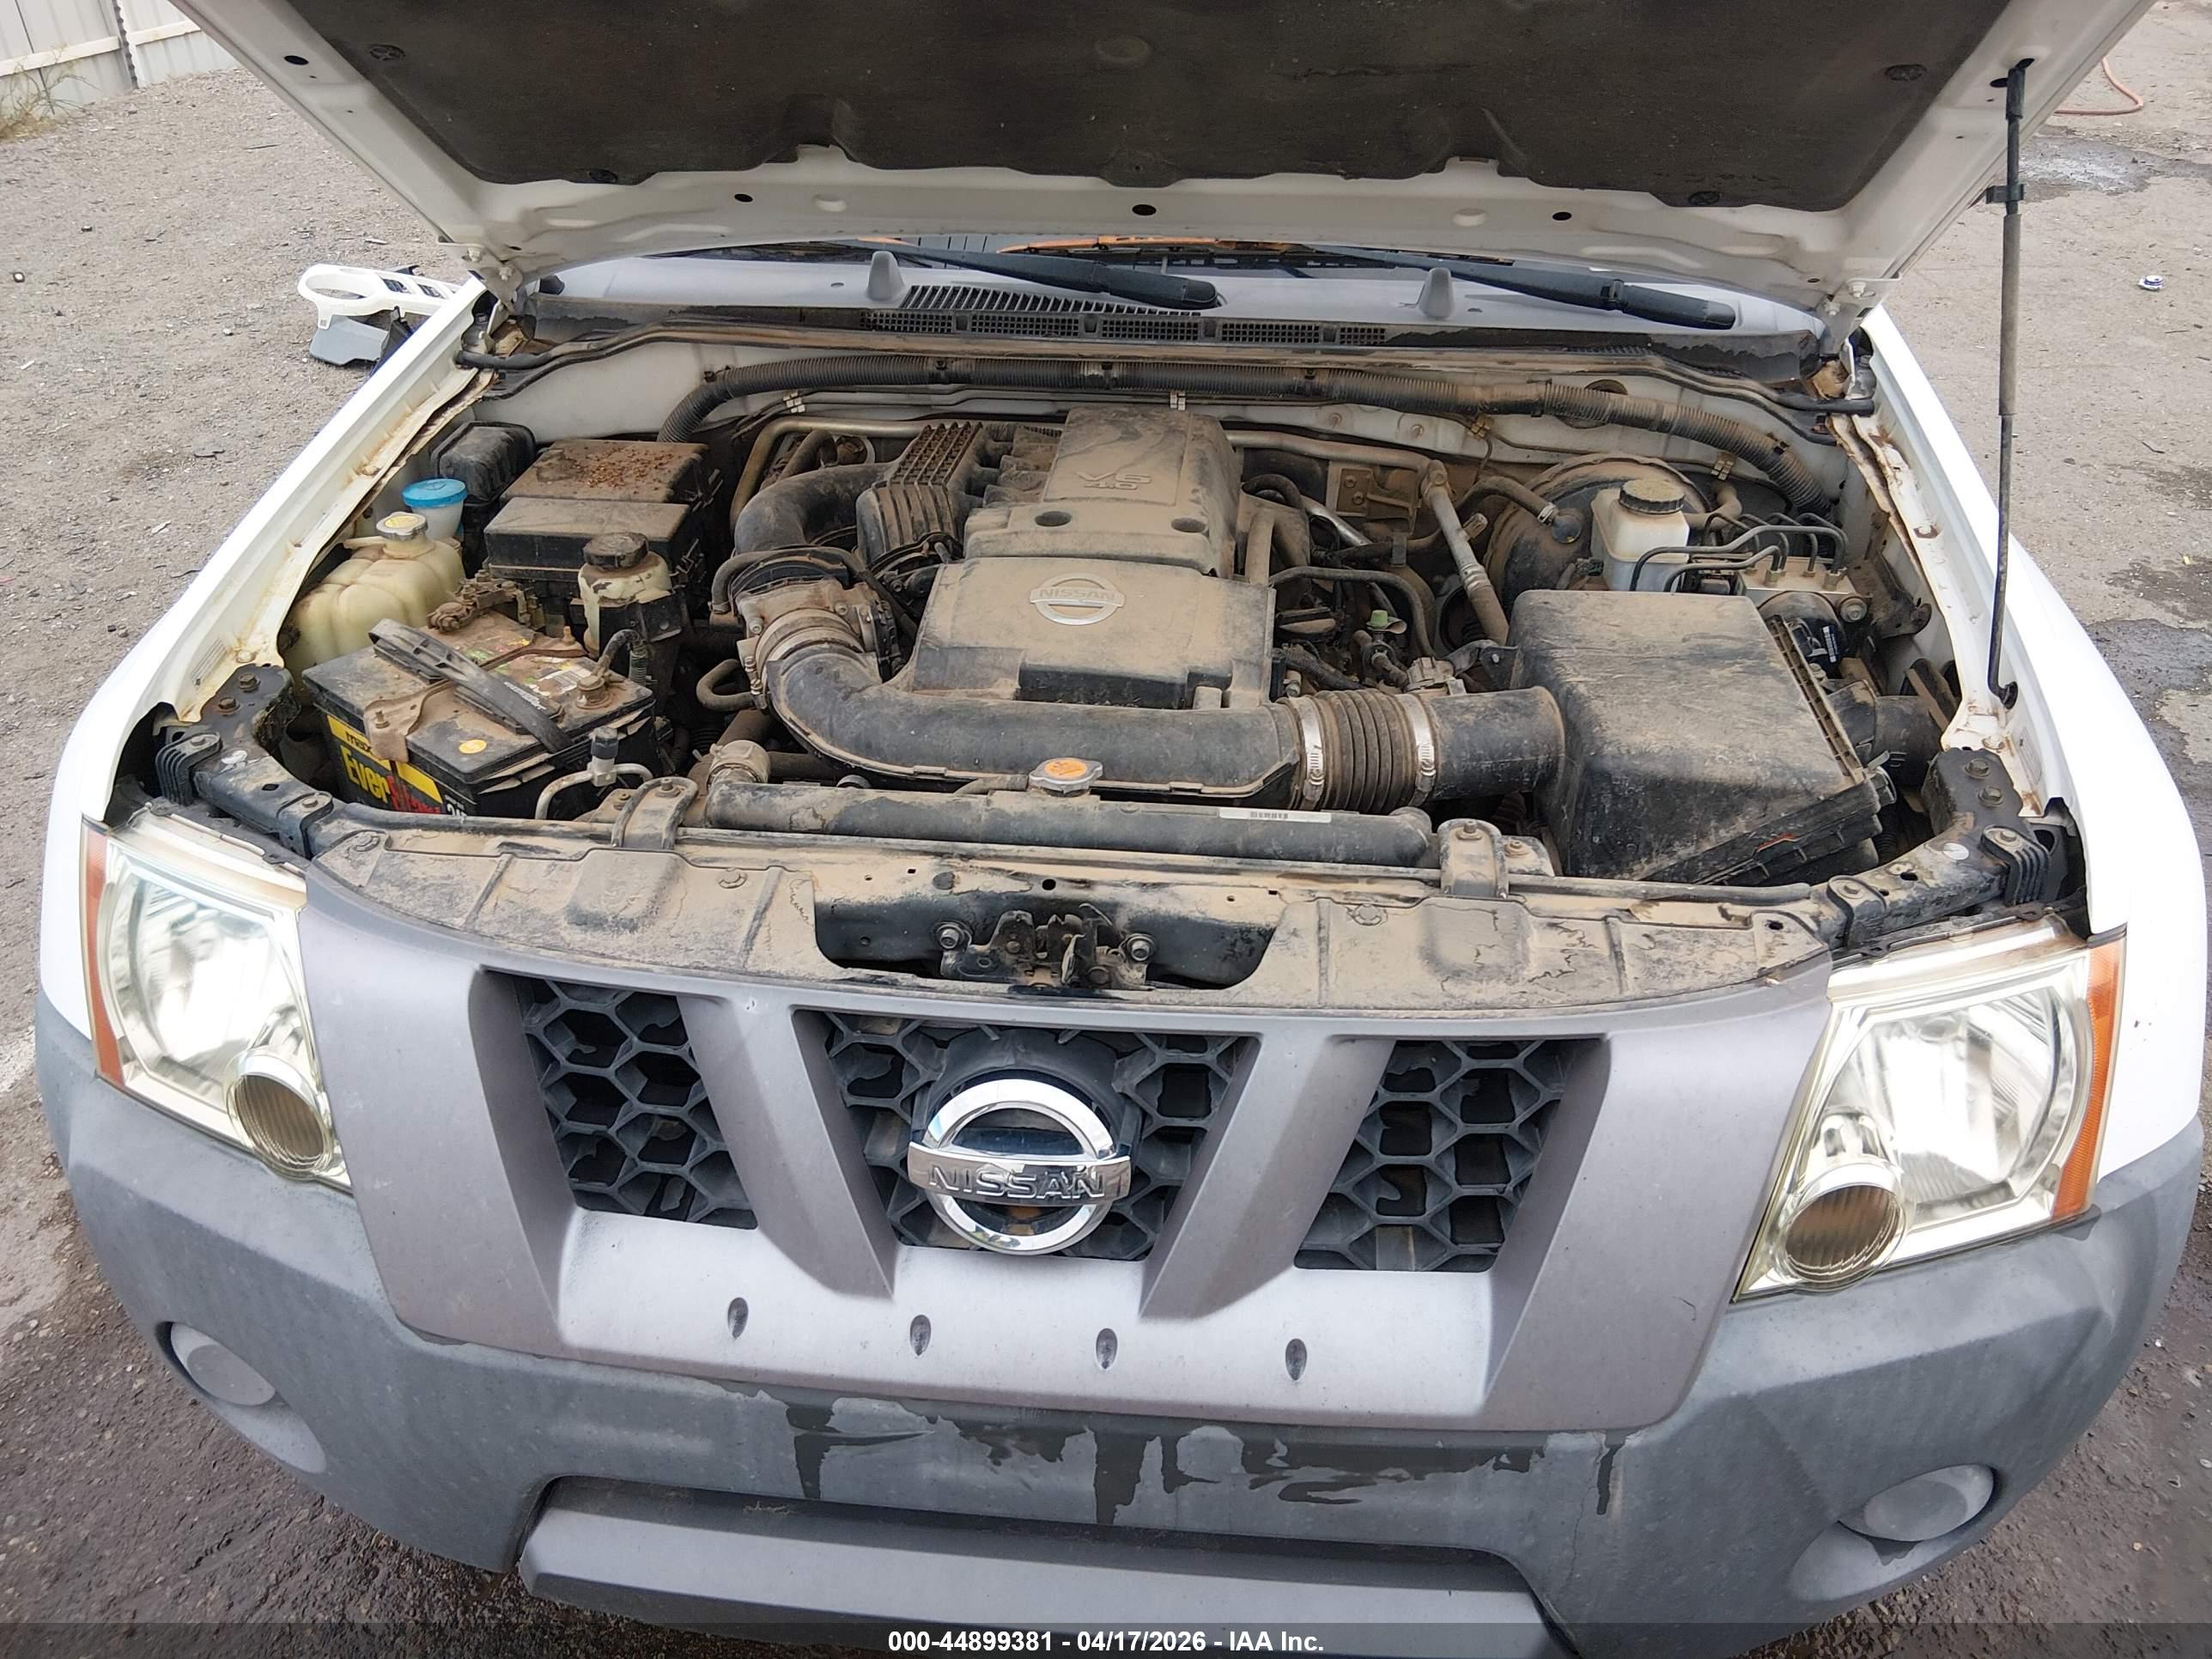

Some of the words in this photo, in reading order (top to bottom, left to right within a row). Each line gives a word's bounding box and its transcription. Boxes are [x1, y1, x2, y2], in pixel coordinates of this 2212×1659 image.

[1077, 471, 1153, 485] V6
[1039, 587, 1115, 600] NISSAN
[929, 1164, 1105, 1200] NISSAN
